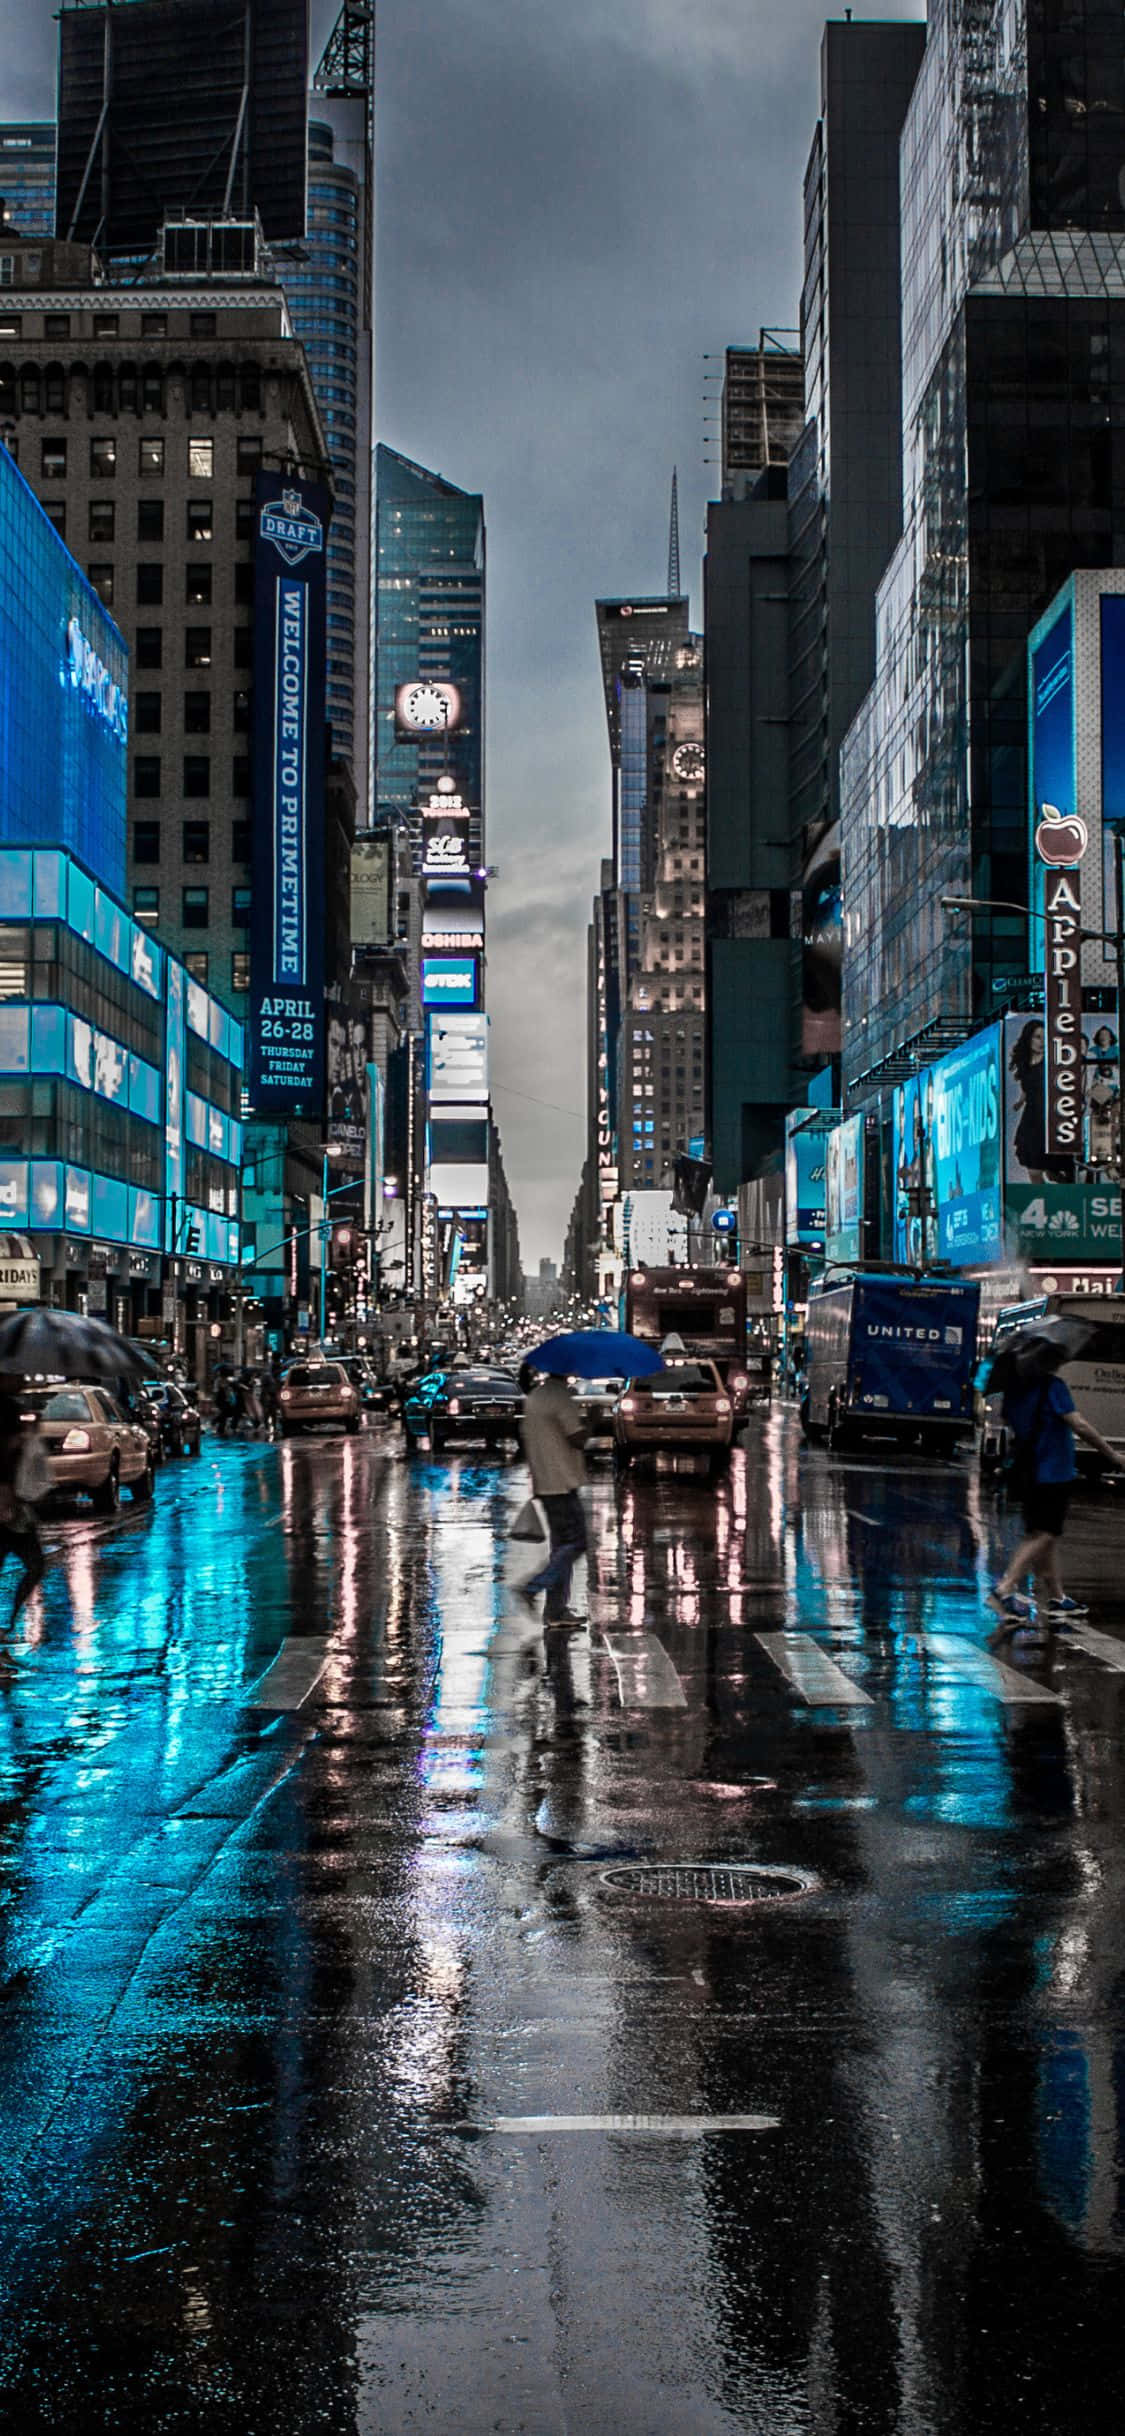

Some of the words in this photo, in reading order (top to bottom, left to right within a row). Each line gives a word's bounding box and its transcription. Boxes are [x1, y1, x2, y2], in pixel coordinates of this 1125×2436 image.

[265, 518, 317, 542] DRAFT
[282, 590, 300, 739] WELCOME
[281, 748, 298, 786] TO
[280, 796, 299, 973] PRIMETIME
[804, 931, 841, 945] MAY
[260, 997, 316, 1019] APRIL
[1048, 878, 1082, 1144] Applebee's
[260, 1020, 315, 1041] 26-28
[260, 1046, 315, 1059] THURSDAY
[268, 1061, 305, 1072] FRIDAY
[260, 1074, 313, 1087] SATURDAY
[1020, 1197, 1048, 1229] 4
[1091, 1224, 1122, 1238] WE
[867, 1325, 940, 1340] UNITED
